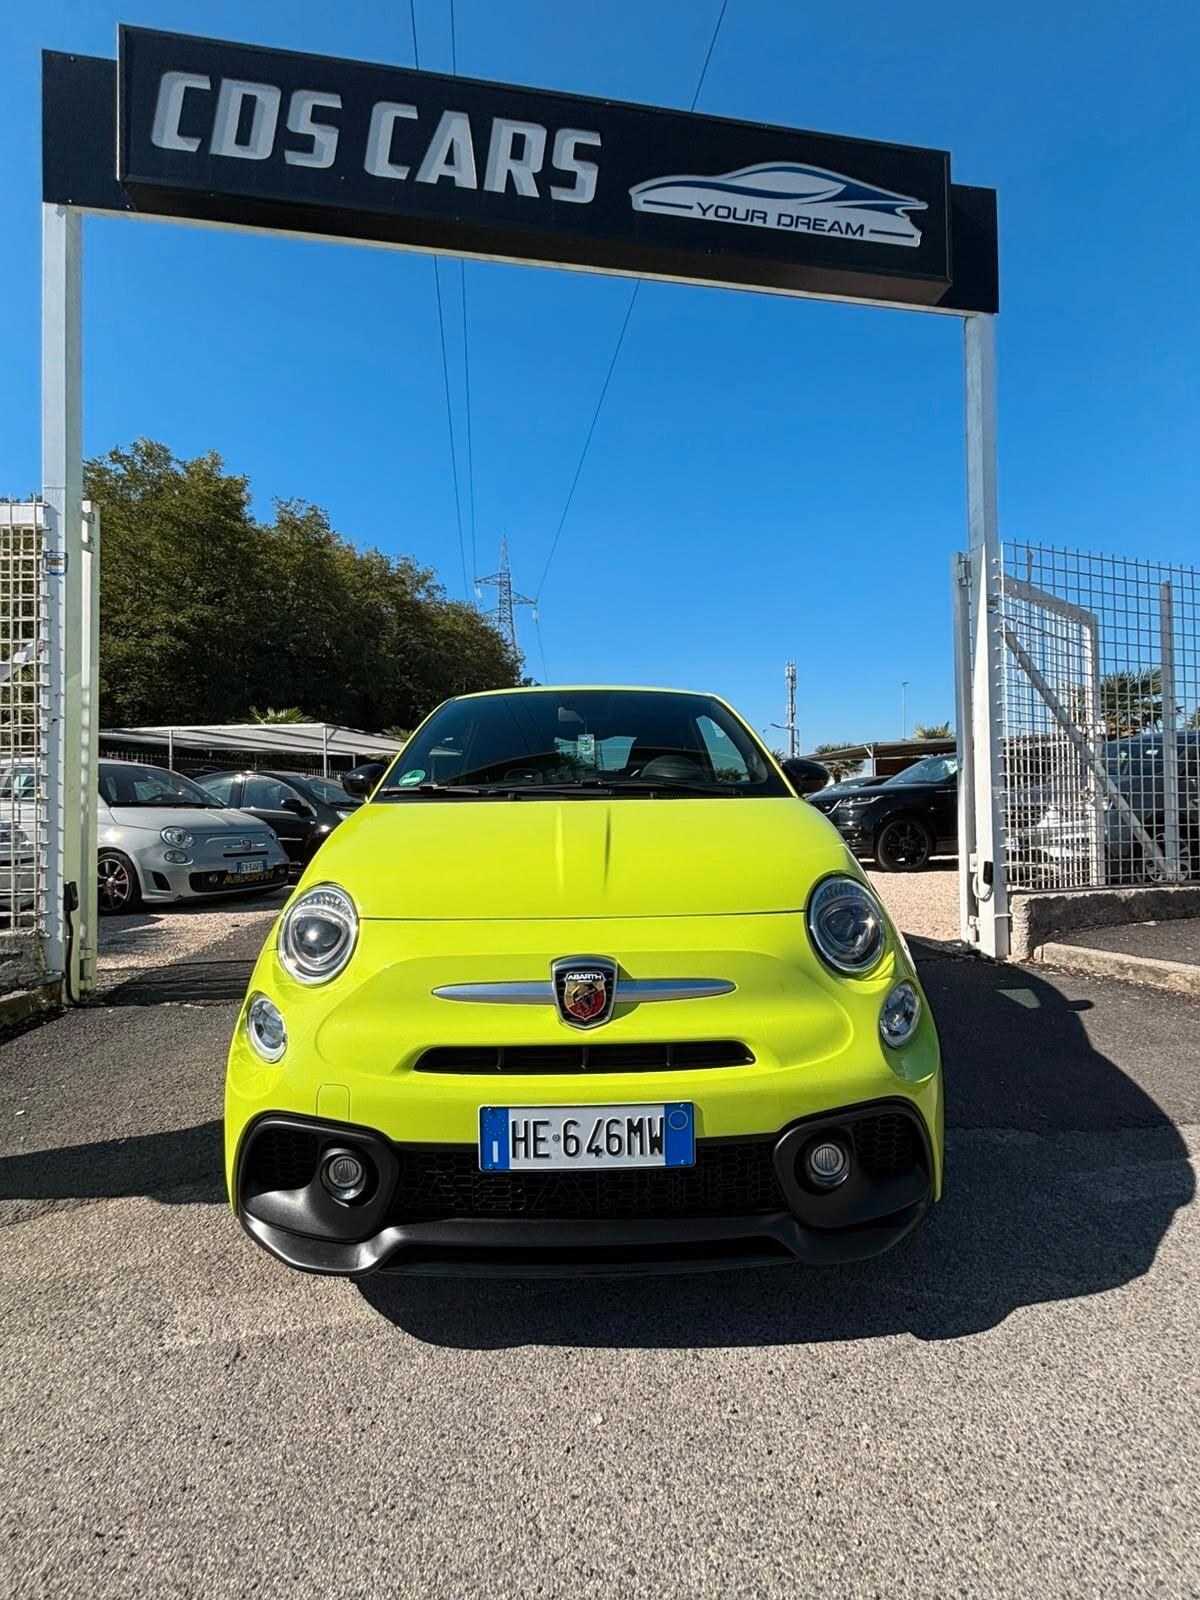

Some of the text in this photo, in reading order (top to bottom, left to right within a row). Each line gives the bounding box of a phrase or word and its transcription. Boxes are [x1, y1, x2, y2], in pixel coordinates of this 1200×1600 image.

[150, 71, 602, 204] CDS CARS
[696, 201, 865, 237] YOUR DREAM
[511, 1116, 664, 1159] HE 646MW
